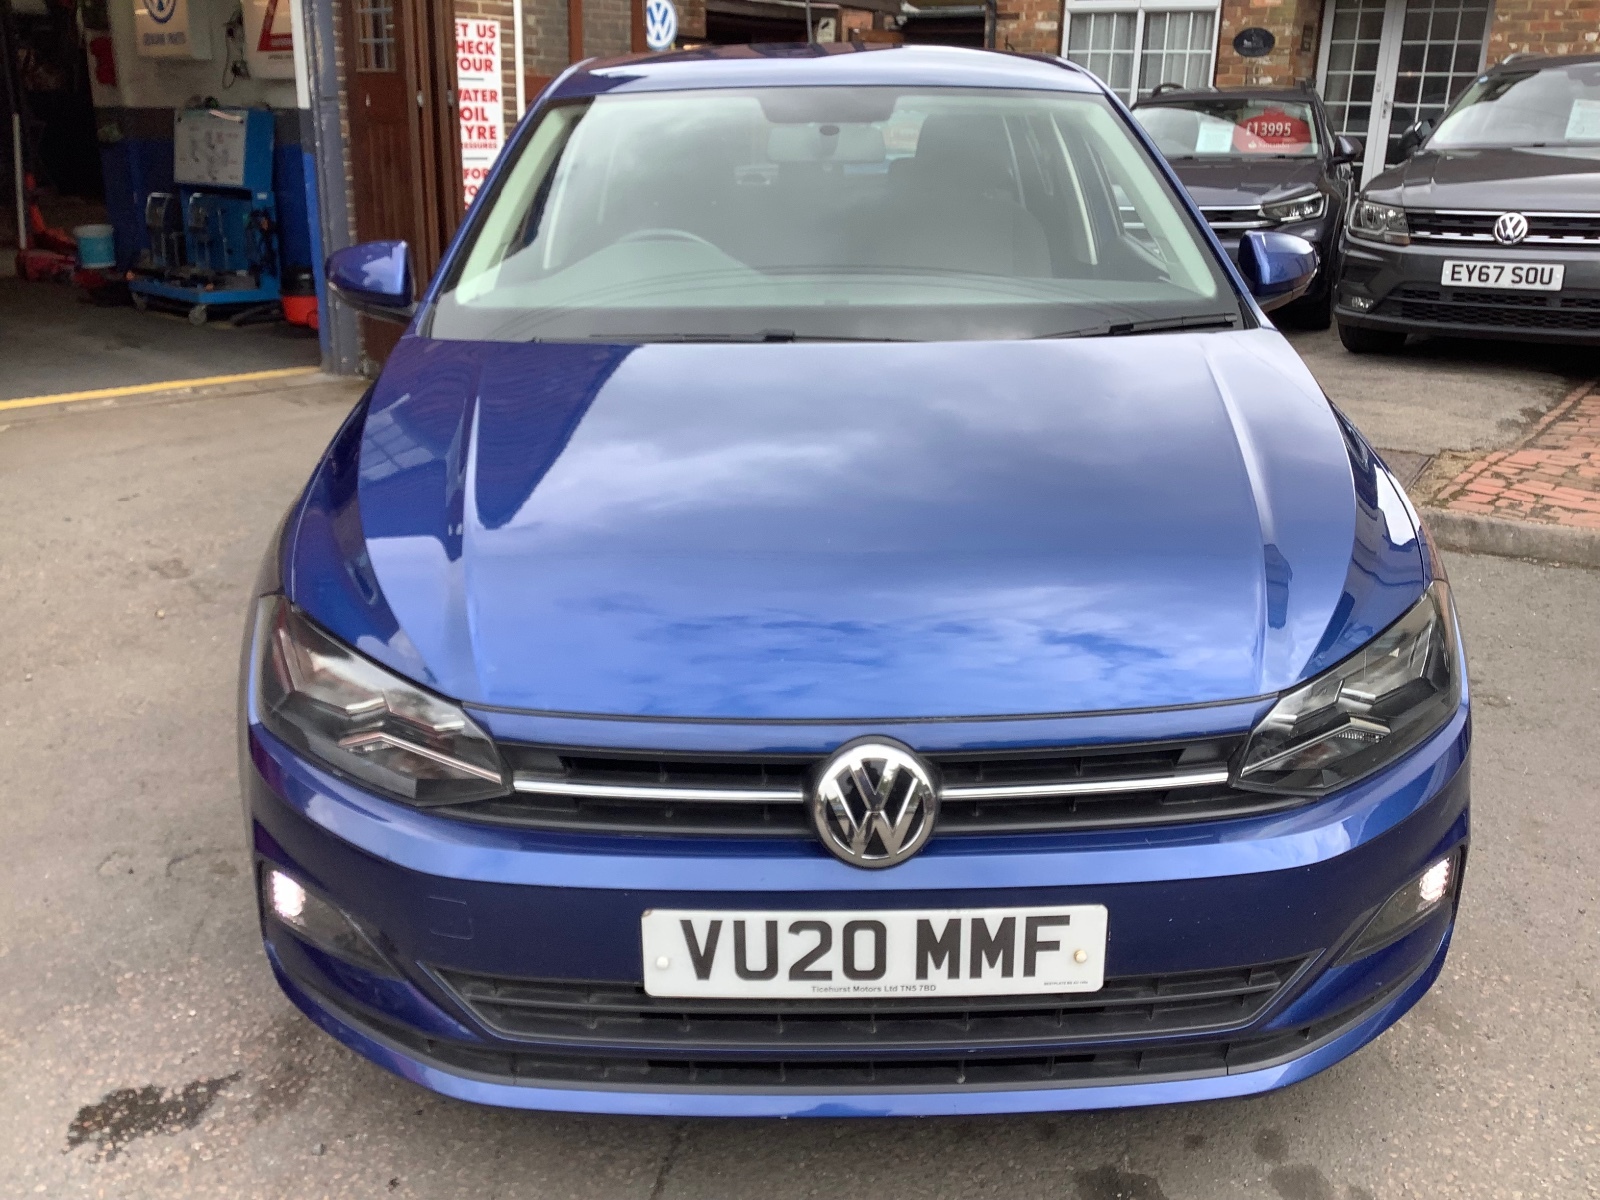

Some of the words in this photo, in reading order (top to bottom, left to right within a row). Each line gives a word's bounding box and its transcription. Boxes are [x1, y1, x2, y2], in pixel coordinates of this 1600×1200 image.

[455, 23, 468, 37] ET
[477, 24, 496, 38] US
[456, 40, 495, 55] HECK
[458, 58, 493, 72] OUR
[461, 106, 488, 121] OIL
[465, 125, 497, 139] YRE
[1246, 122, 1291, 137] £13995
[1450, 264, 1505, 283] EY67
[1511, 266, 1554, 285] SOU
[680, 919, 887, 981] VU20
[915, 914, 1070, 980] MMF
[811, 985, 850, 993] Ticehurst
[853, 985, 881, 993] Motors
[919, 984, 936, 992] 7BD
